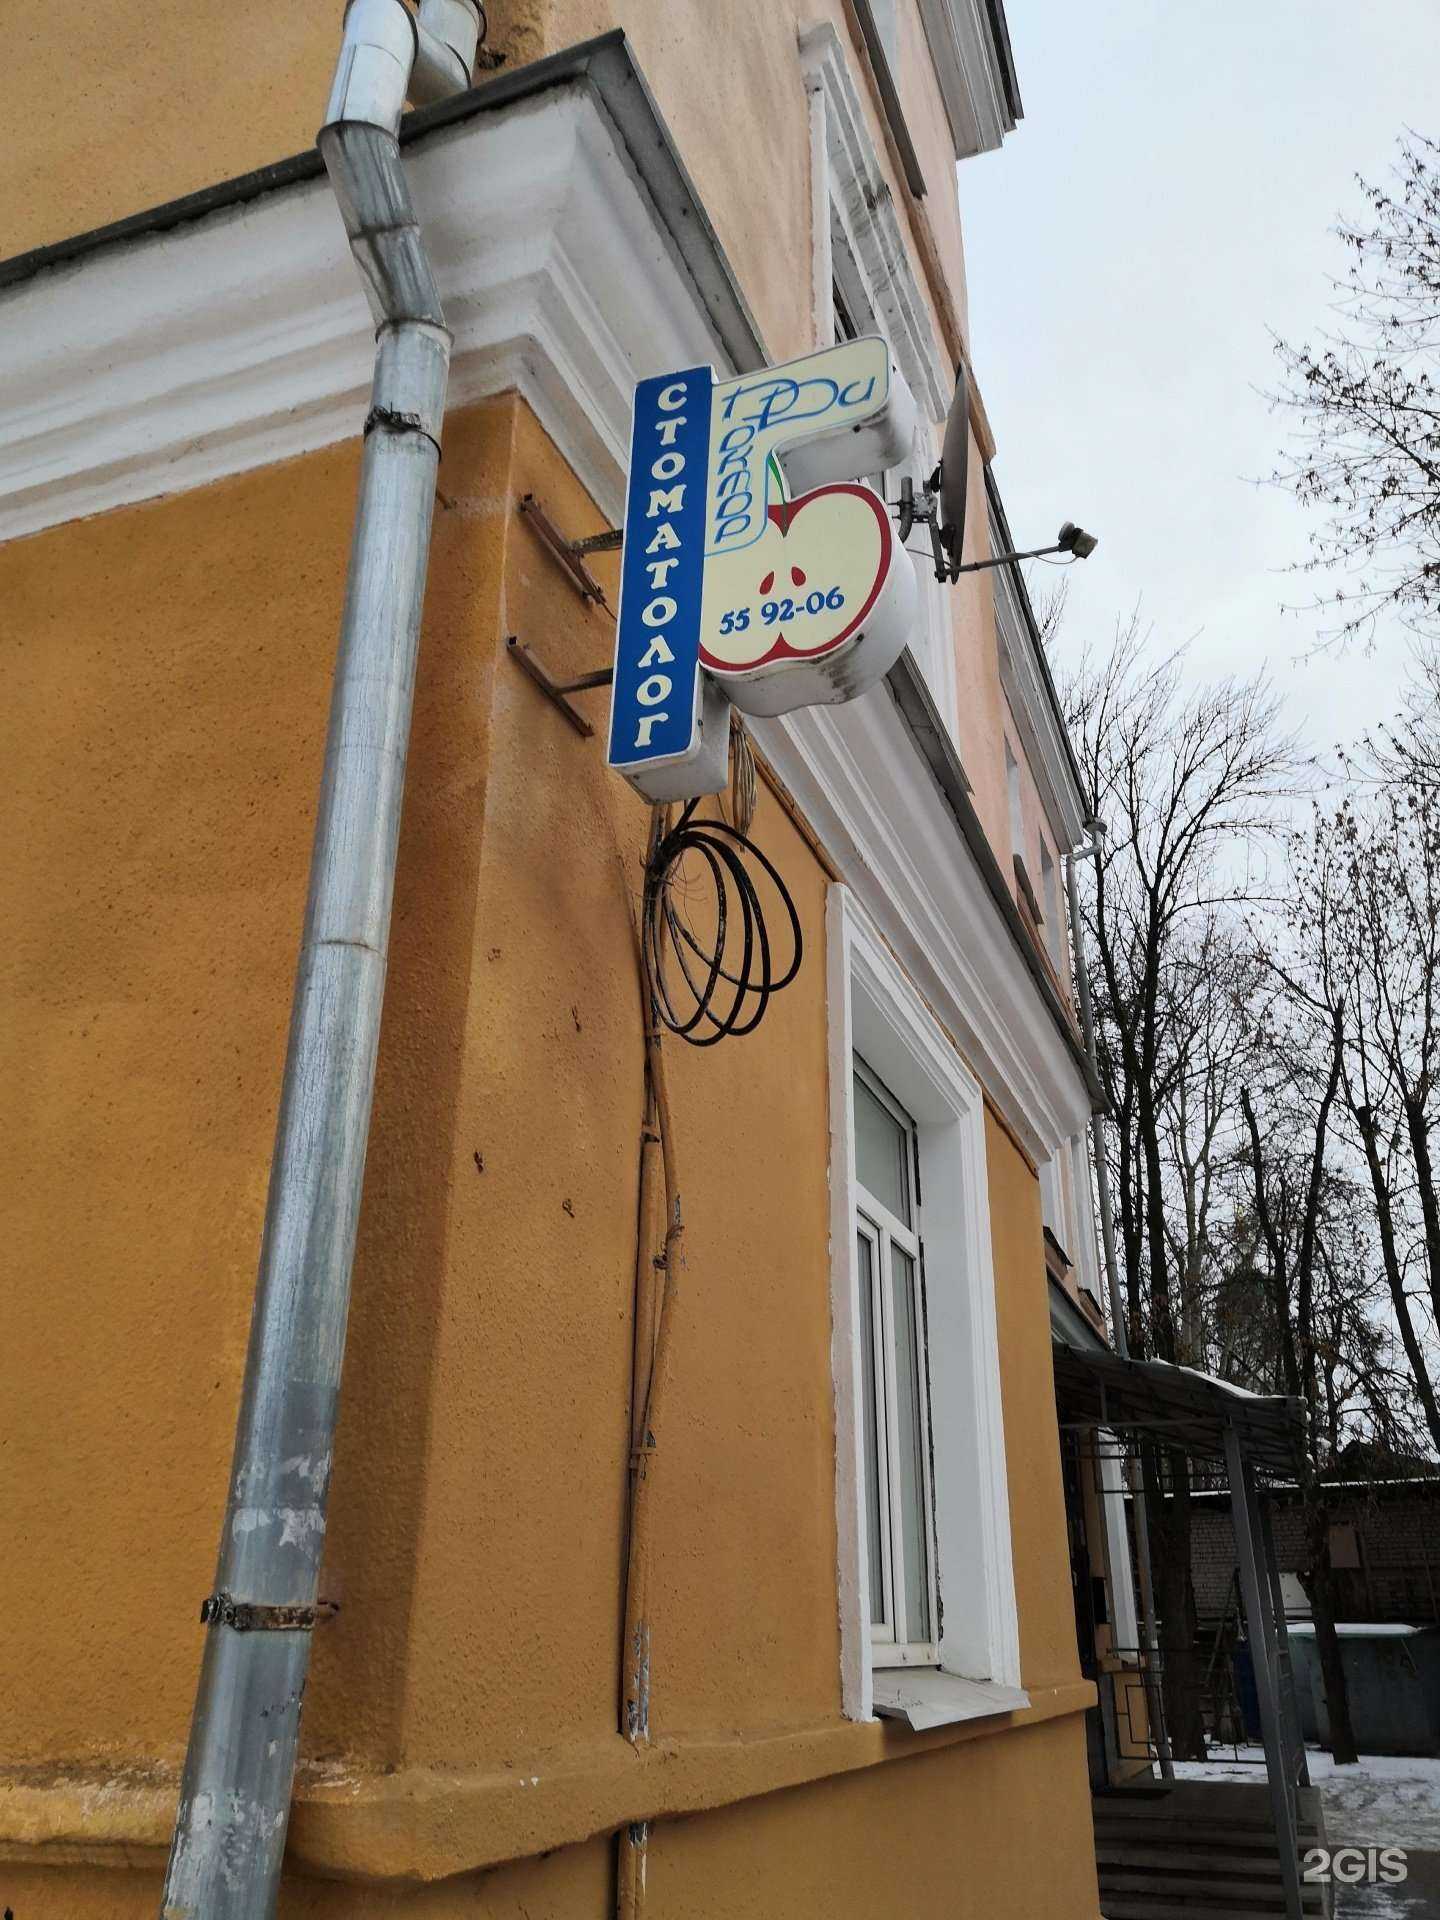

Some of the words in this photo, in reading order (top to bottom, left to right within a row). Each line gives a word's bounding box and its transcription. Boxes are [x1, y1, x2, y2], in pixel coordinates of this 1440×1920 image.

[634, 382, 687, 748] СТОМАТОЛОГ
[719, 607, 751, 635] 55
[761, 586, 845, 625] 92-06
